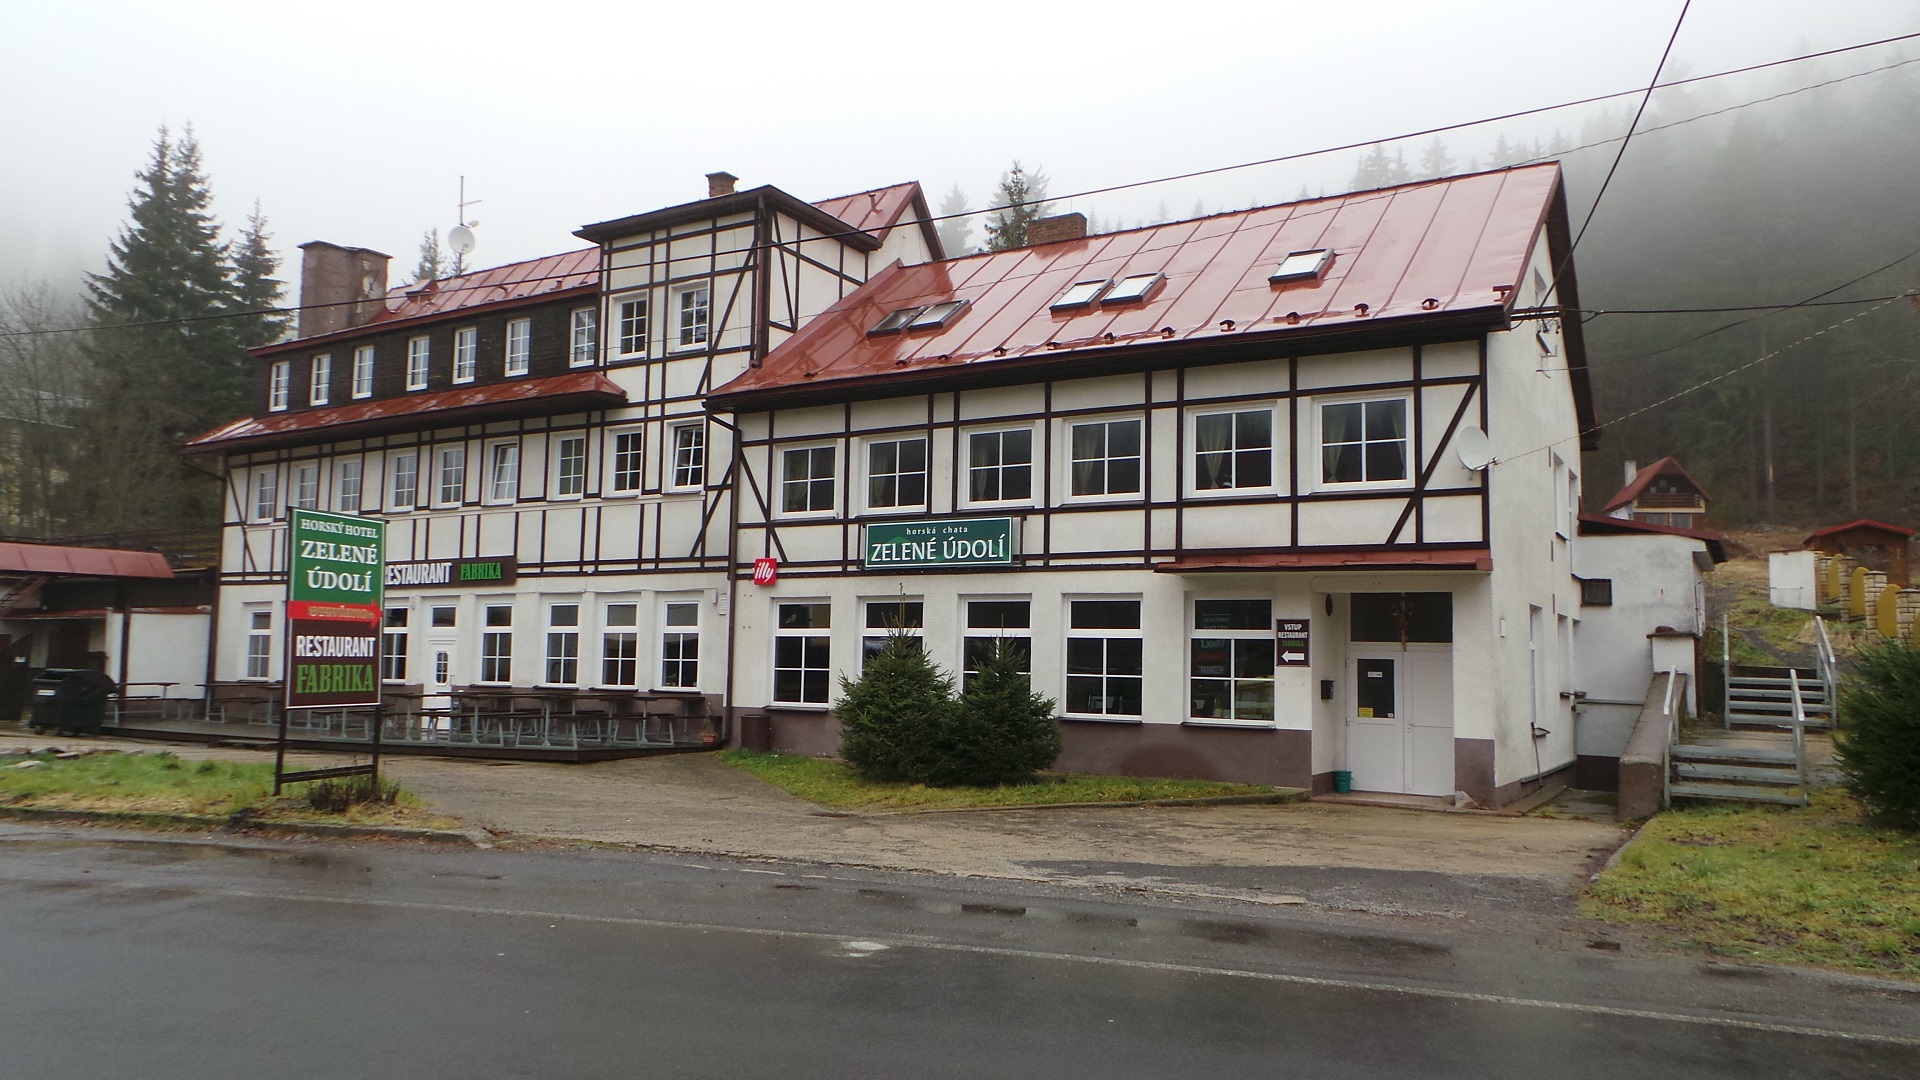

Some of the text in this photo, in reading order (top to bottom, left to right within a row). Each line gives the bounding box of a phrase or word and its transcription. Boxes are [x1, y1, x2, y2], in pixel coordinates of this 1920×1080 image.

[301, 519, 378, 538] HORSKÝ HOTEL
[906, 526, 968, 535] horská chata
[301, 540, 378, 565] ZELENÉ
[871, 534, 1006, 562] ZELENÉ ÚDOLÍ
[307, 566, 372, 592] ÚDOLÍ
[461, 562, 502, 580] FABRIKA
[755, 562, 774, 583] illy
[1284, 623, 1303, 631] VSTUP
[296, 635, 376, 657] RESTAURANT
[295, 664, 375, 694] FABRIKA
